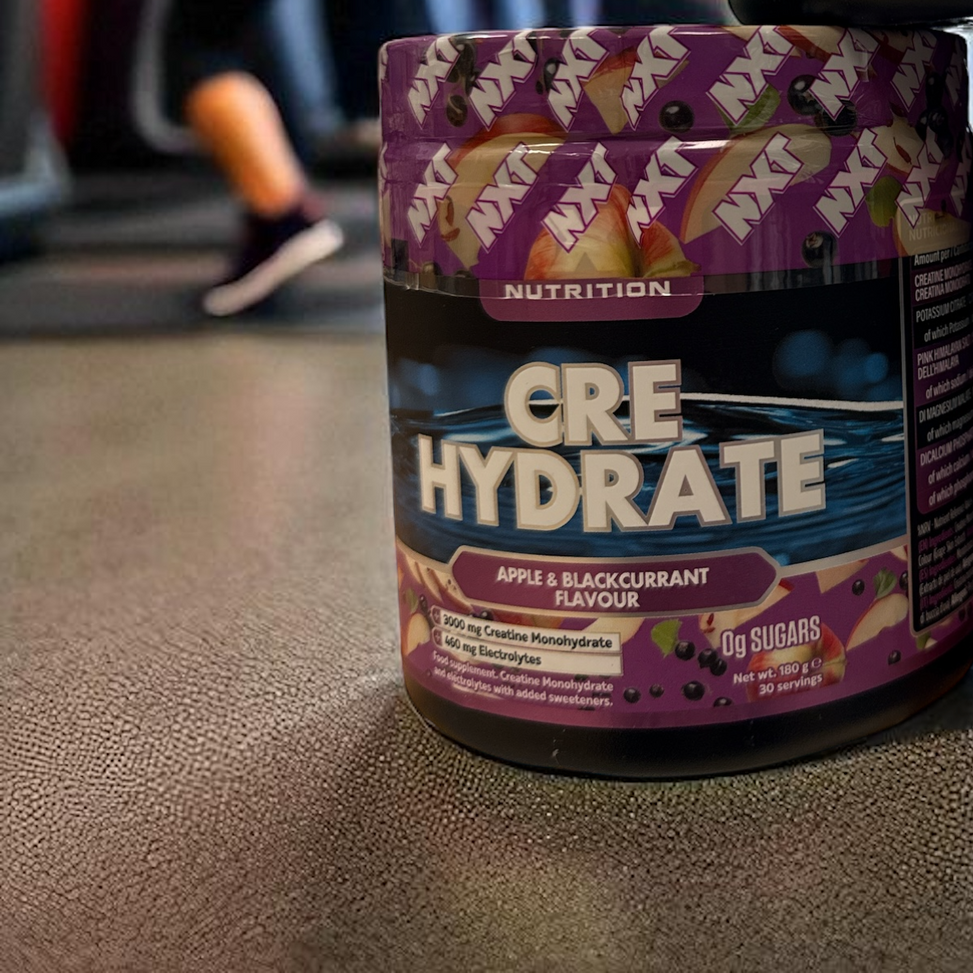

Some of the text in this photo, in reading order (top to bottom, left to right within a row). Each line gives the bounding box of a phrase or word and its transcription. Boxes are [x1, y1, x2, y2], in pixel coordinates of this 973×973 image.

[408, 32, 460, 129] NXT
[468, 30, 538, 131] NXT
[548, 27, 610, 133] NXT
[620, 27, 691, 131] NXT
[703, 26, 794, 126] NXT
[626, 135, 699, 249] NXT
[712, 131, 804, 245] NXT
[812, 127, 888, 238] NXT
[895, 126, 944, 229] NXT
[408, 143, 458, 248] NXT
[465, 141, 539, 254] NXT
[541, 142, 617, 254] NXT
[914, 253, 940, 266] Amount
[505, 280, 671, 299] NUTRITION
[914, 271, 944, 288] CREATINE
[915, 285, 944, 302] CREATINA
[916, 305, 949, 323] POTASSIUM
[924, 331, 931, 342] of
[917, 352, 934, 366] PINK
[504, 359, 682, 447] CRE
[925, 387, 933, 399] of
[927, 429, 934, 442] of
[418, 428, 826, 532] HYDRATE
[928, 472, 935, 484] of
[928, 493, 936, 506] of
[497, 566, 709, 589] APPLE & BLACKCURRANT
[555, 590, 640, 608] FLAVOUR
[443, 614, 612, 650] 3000 mg Creatine Monohydrate
[722, 615, 820, 658] 0g SUGARS
[445, 635, 542, 665] 460 mg Electrolytes
[447, 671, 492, 692] electrolytes
[494, 684, 514, 695] with
[516, 688, 546, 700] added
[549, 694, 613, 707] sweeteners.
[450, 658, 499, 678] supplement.
[500, 670, 539, 685] Creatine
[542, 676, 613, 692] Monohydrate
[733, 662, 809, 684] Net wt. 180 g
[759, 674, 822, 695] 30 servings
